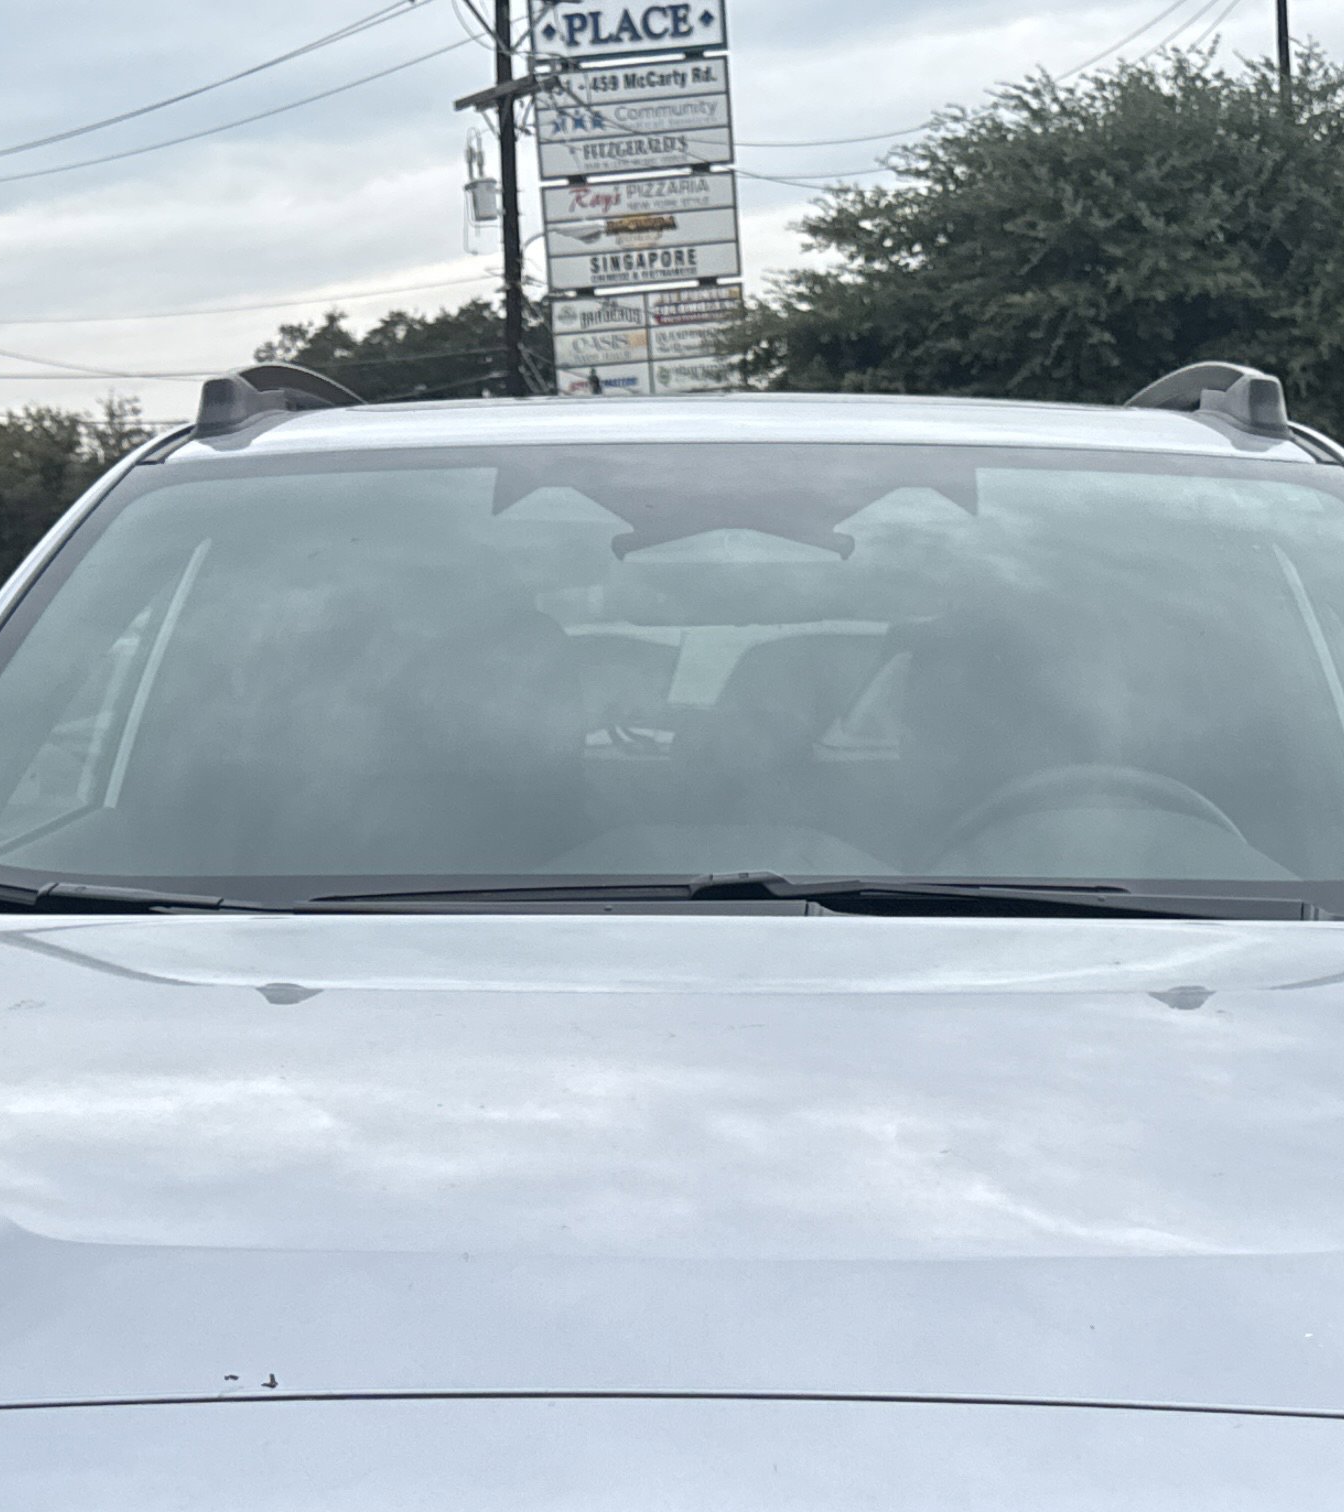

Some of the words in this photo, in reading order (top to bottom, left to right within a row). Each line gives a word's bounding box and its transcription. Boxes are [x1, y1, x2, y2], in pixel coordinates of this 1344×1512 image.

[562, 4, 693, 46] PLACE
[591, 75, 619, 92] 459
[623, 69, 688, 89] McCarty
[691, 66, 718, 83] Rd.
[614, 99, 719, 122] Community
[626, 179, 710, 199] PIZZARIA
[590, 248, 697, 274] SINGAPORE
